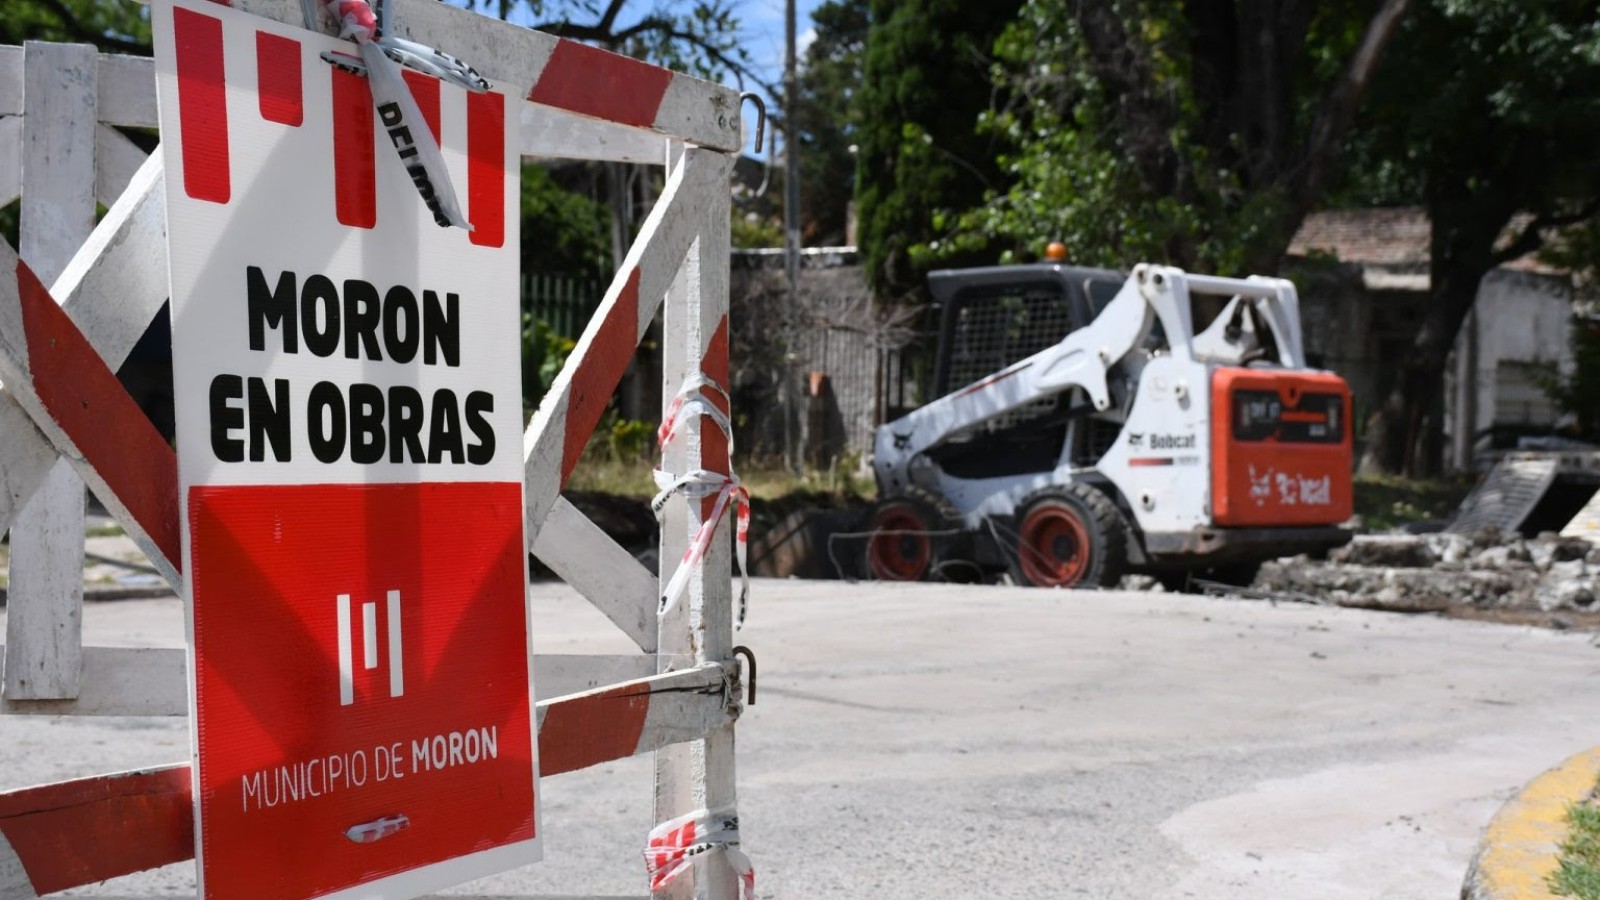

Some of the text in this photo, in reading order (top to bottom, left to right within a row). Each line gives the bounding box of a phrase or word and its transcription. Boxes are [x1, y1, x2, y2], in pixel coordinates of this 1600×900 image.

[247, 265, 460, 367] MORON
[209, 374, 496, 465] EN OBRAS
[1149, 433, 1196, 449] Bobcat
[242, 725, 498, 812] MUNICIPIO DE MORON
